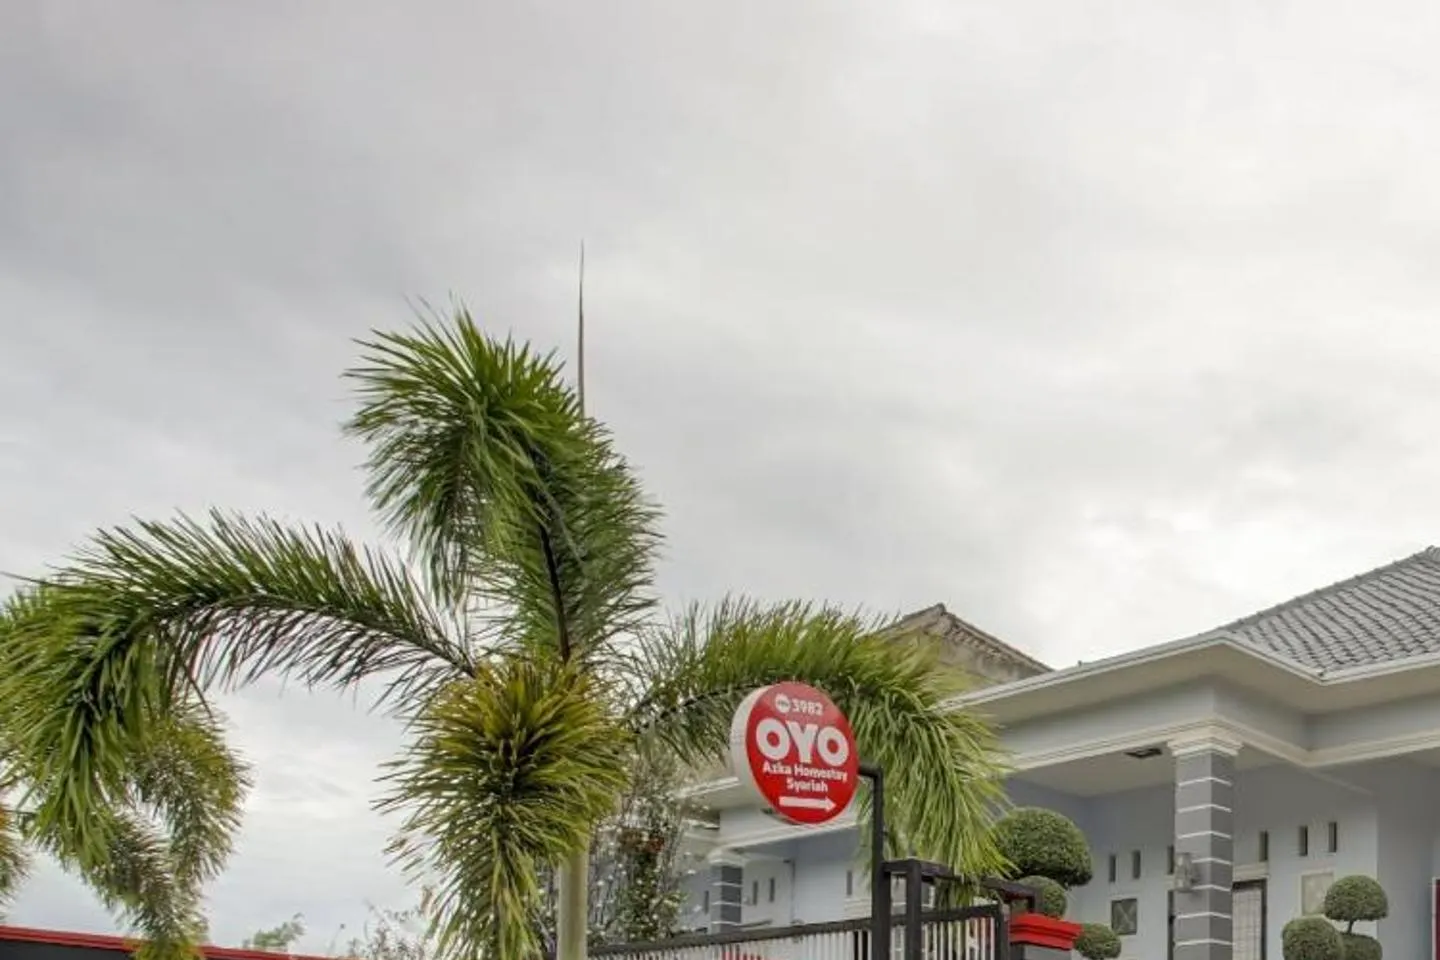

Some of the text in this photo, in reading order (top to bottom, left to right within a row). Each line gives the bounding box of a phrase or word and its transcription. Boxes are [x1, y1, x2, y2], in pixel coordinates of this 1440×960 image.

[792, 698, 823, 716] 3982
[756, 717, 849, 767] OYO
[763, 760, 848, 783] Azka Homestay
[786, 777, 828, 792] Syariah
